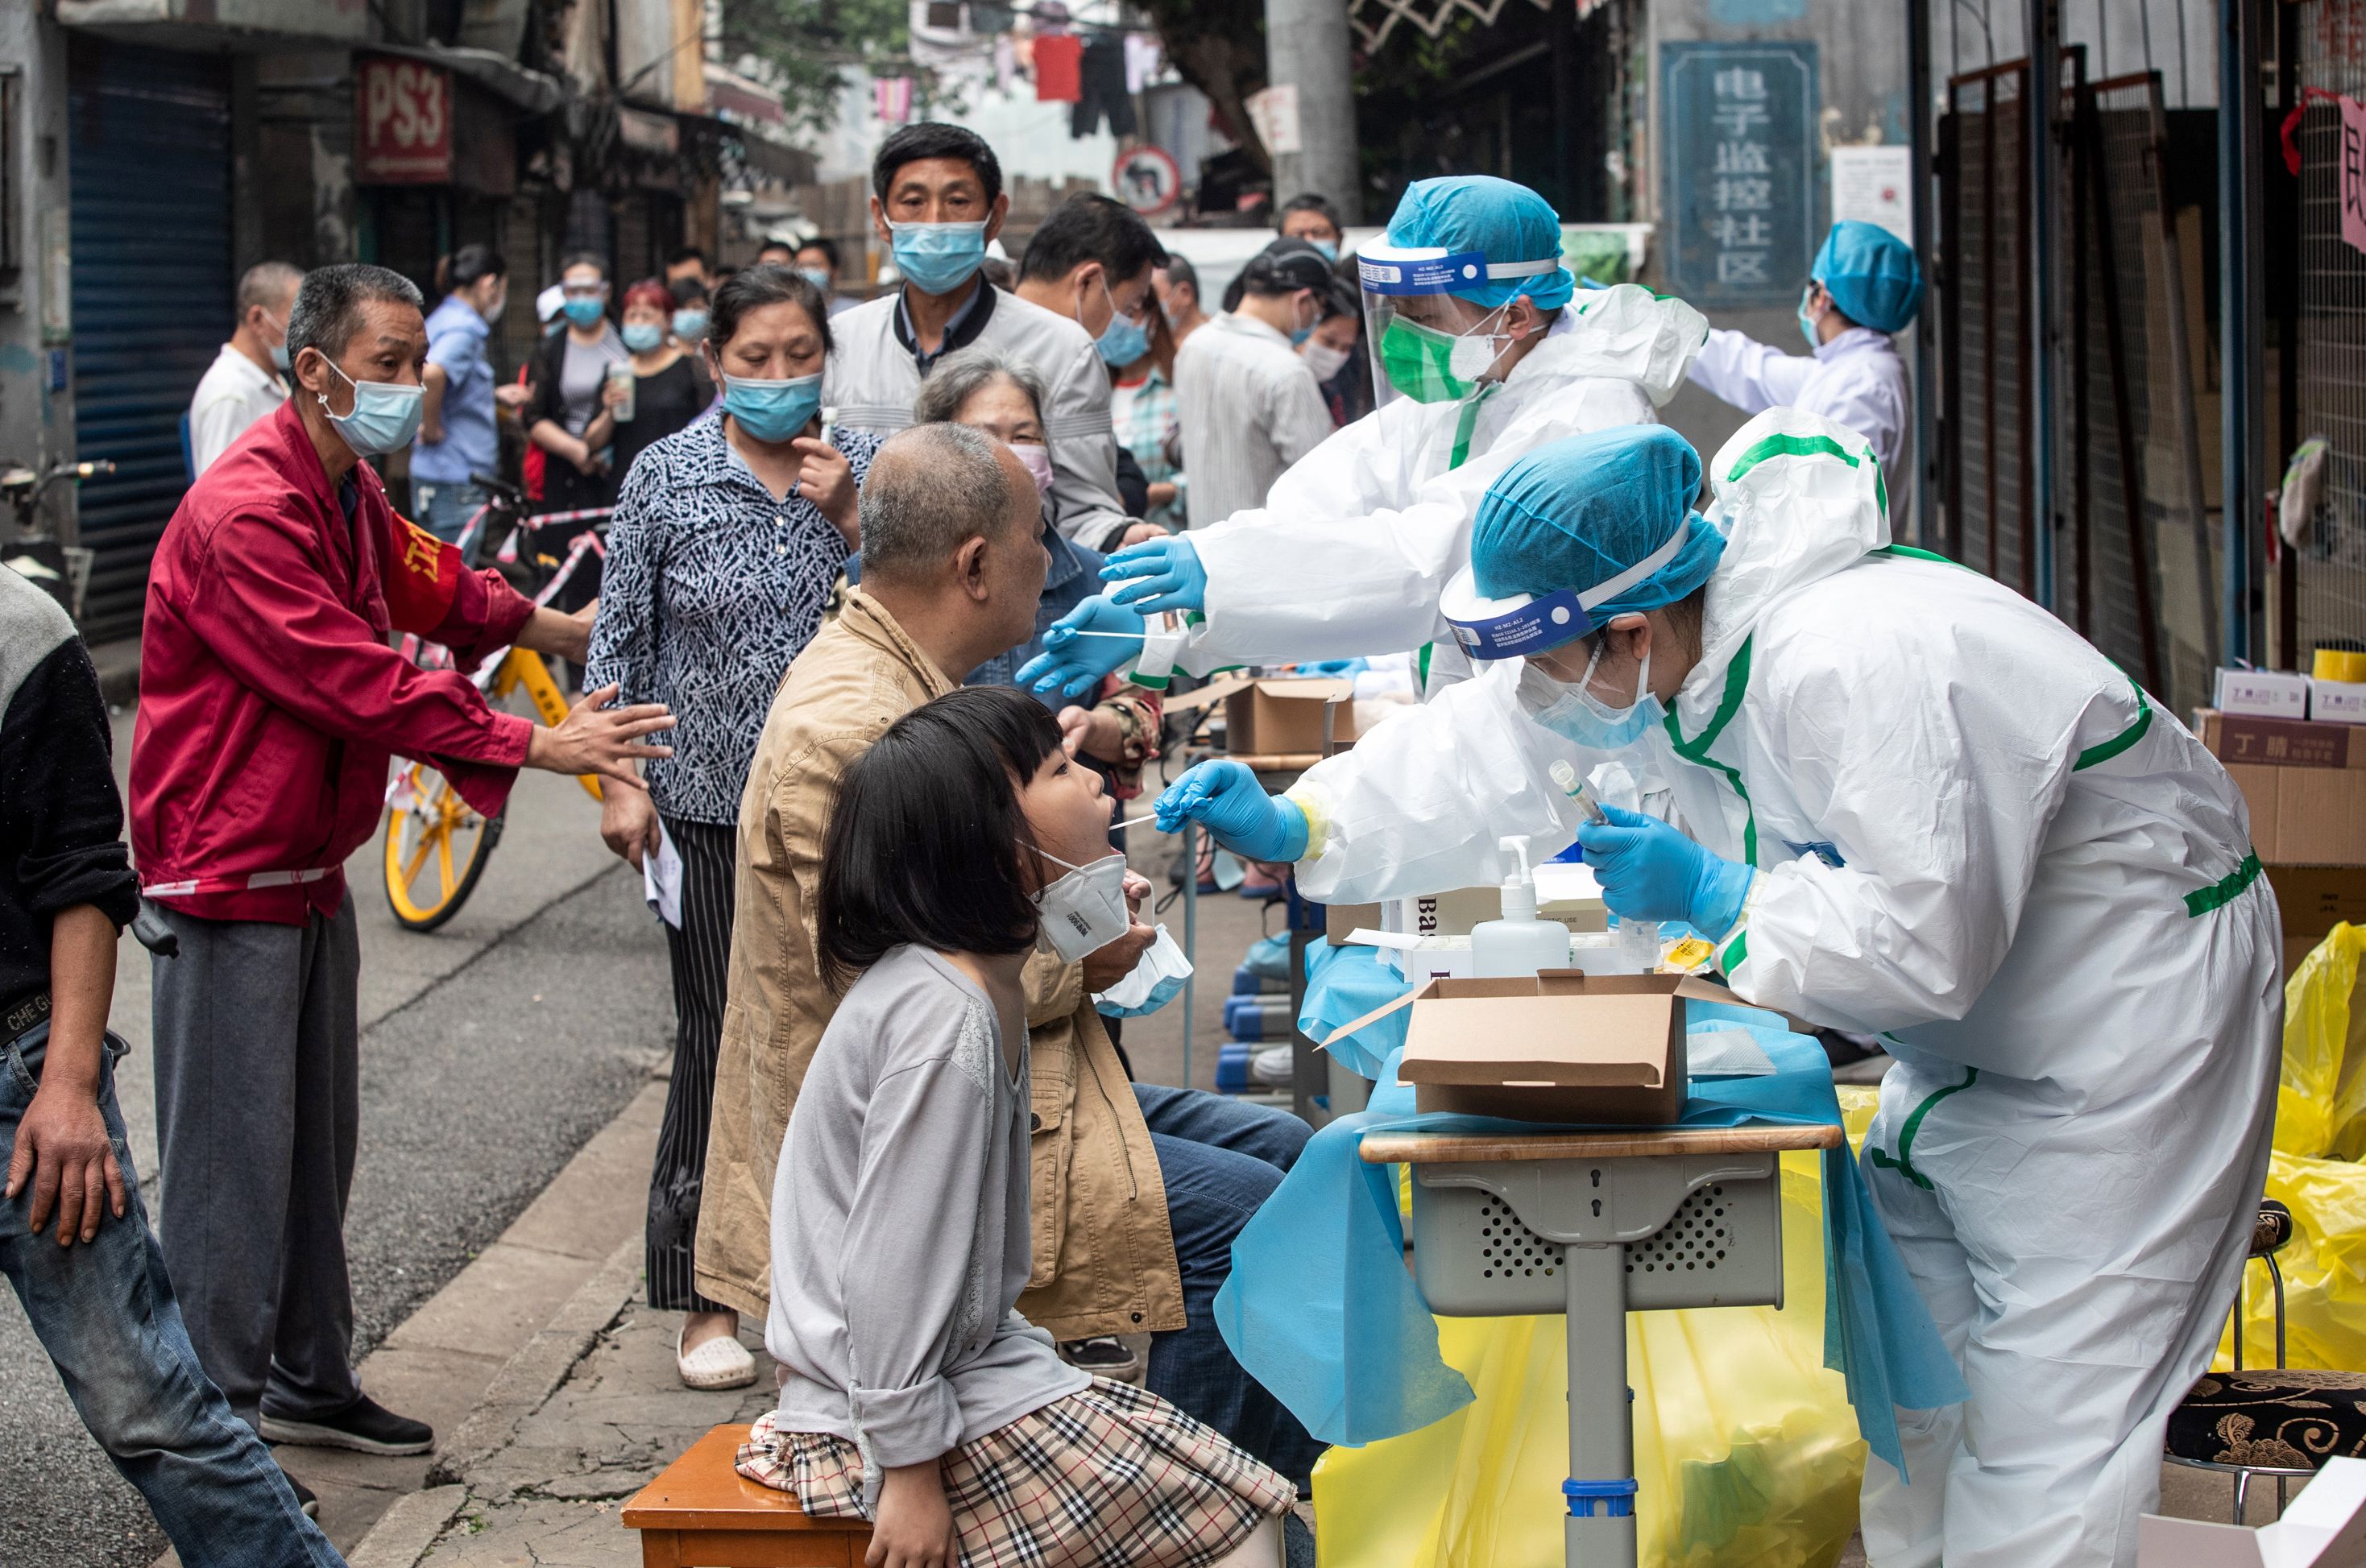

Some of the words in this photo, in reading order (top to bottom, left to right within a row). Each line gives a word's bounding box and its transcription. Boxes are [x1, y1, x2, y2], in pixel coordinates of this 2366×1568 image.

[367, 62, 443, 148] PS3
[1713, 65, 1771, 283] 电子监控社区
[1494, 617, 1523, 631] HZ-MZ-AL2
[1418, 896, 1438, 936] Ba
[7, 1001, 37, 1032] CHE
